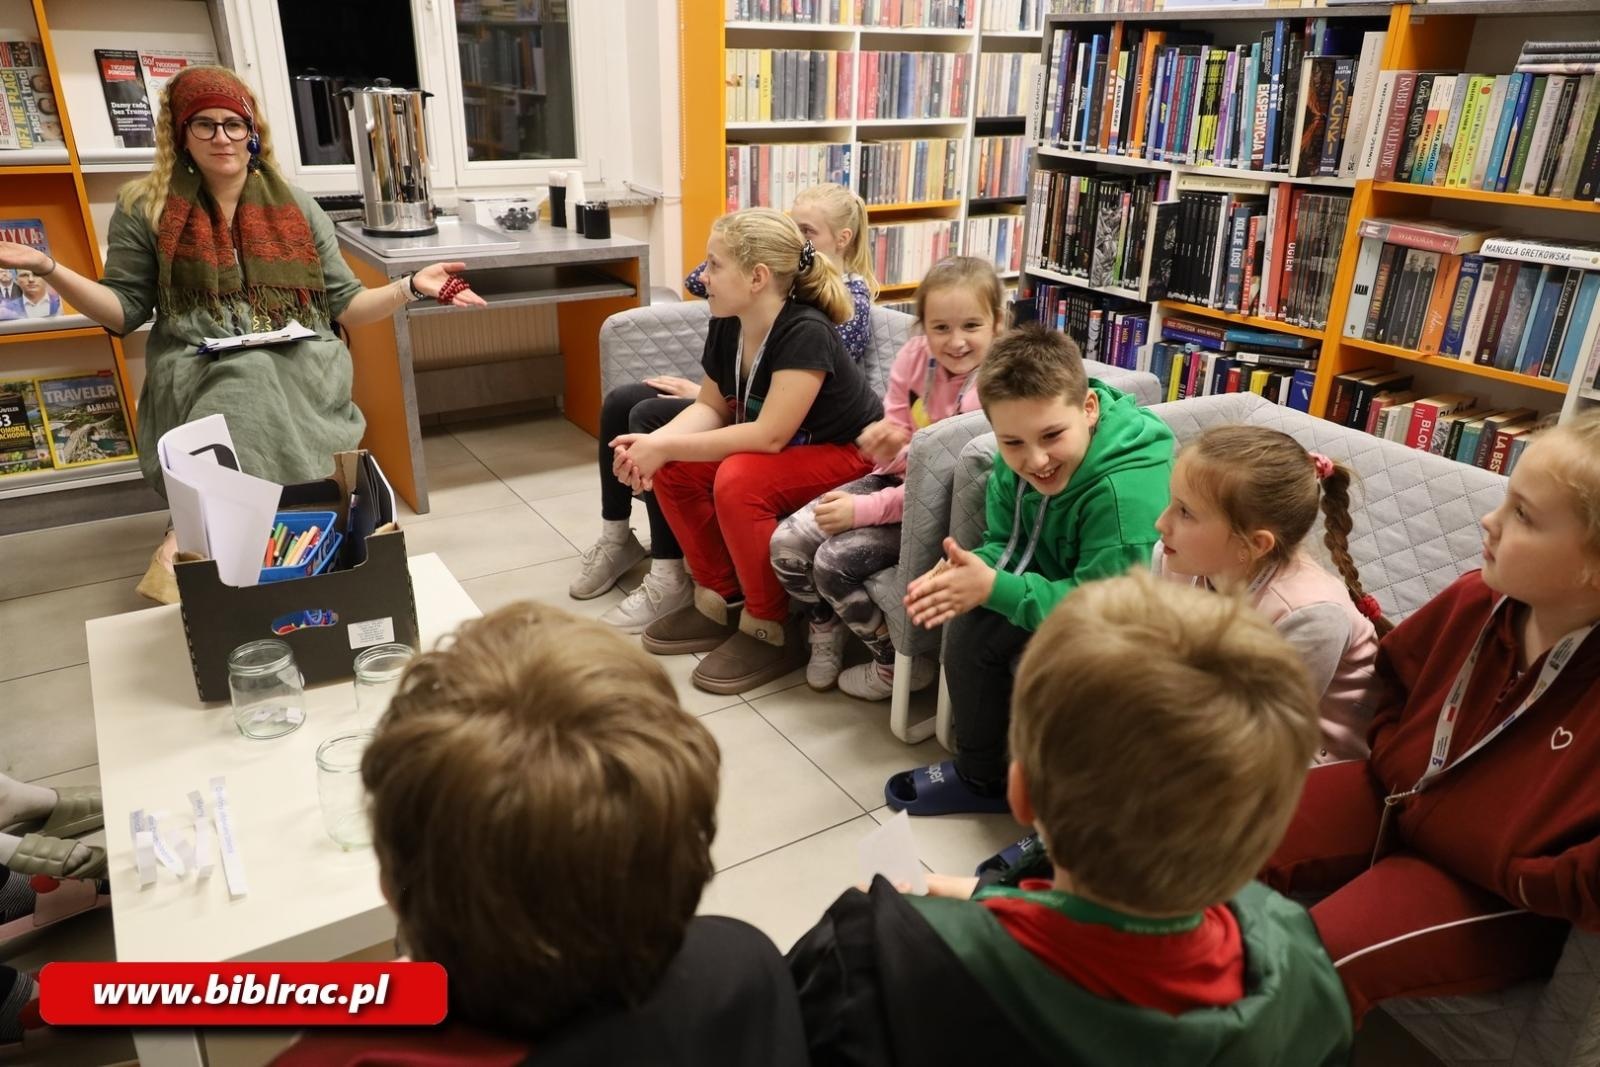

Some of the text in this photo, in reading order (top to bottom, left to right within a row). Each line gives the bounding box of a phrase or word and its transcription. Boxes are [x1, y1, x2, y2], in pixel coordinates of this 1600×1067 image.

[12, 106, 26, 124] NIE
[25, 96, 42, 134] pacjent
[1253, 84, 1270, 151] EKSPEDYCJA
[1327, 79, 1346, 156] KACZKI
[1380, 78, 1412, 168] ISABEL ALLENDE
[18, 126, 32, 148] NFZ
[1416, 124, 1431, 172] MAYA ANGELOU
[1427, 124, 1442, 172] MAYA ANGELOU
[1230, 217, 1245, 268] KOLEJE LOSU
[1486, 244, 1518, 256] MANUELA
[1520, 247, 1571, 262] GRETKOWSKA
[44, 384, 117, 404] TRAVELER
[1495, 436, 1508, 448] LA
